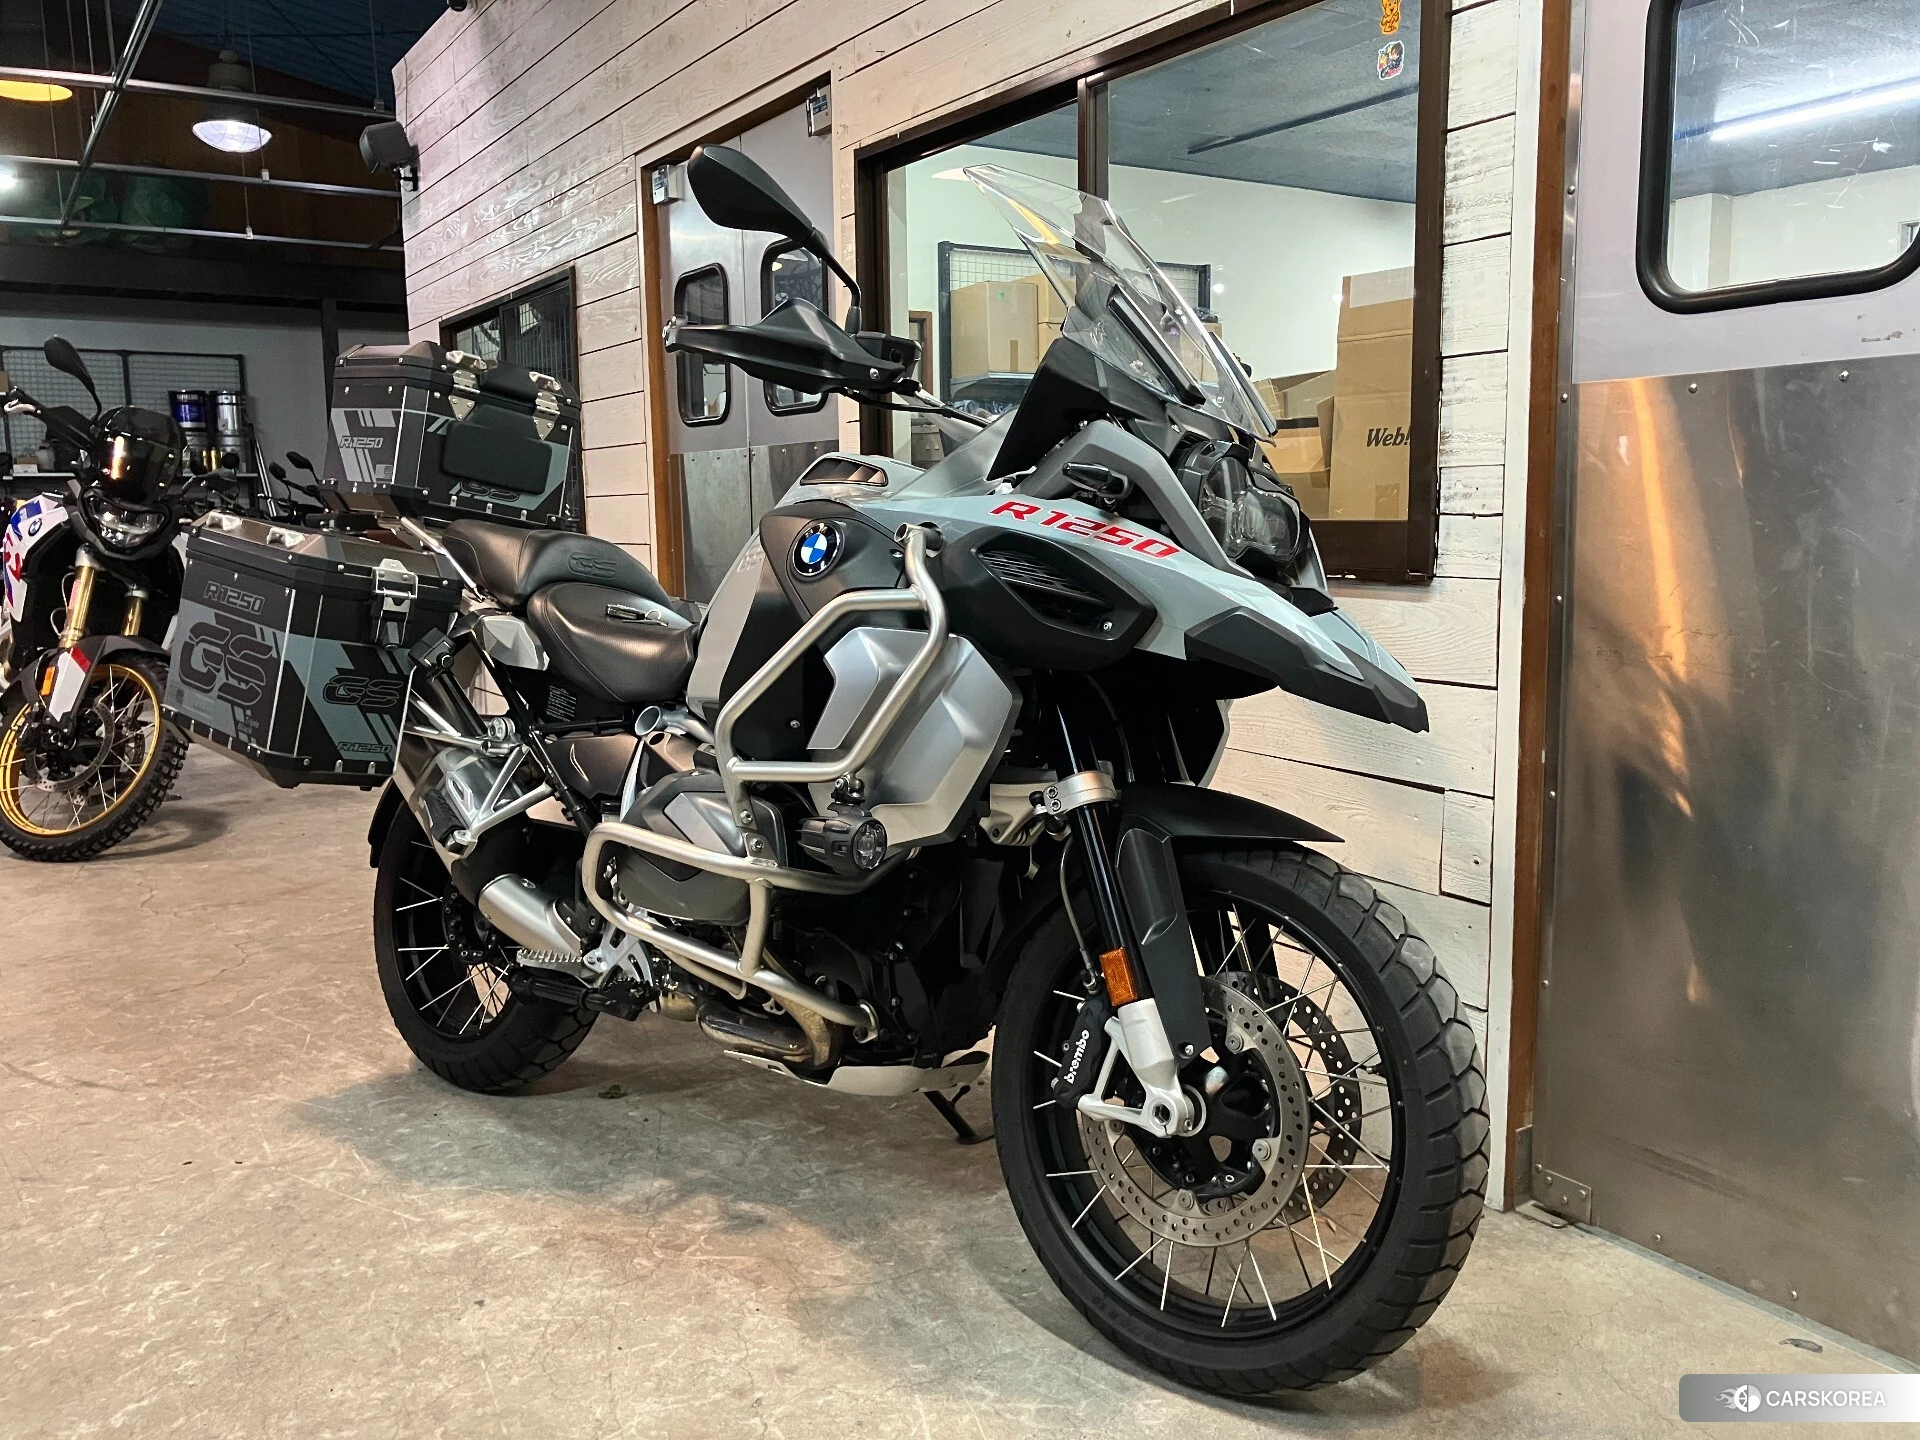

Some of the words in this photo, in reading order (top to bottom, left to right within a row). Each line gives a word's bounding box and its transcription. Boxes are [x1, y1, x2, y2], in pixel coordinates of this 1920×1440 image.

[203, 580, 265, 615] R1250
[179, 621, 273, 706] GS
[323, 675, 404, 708] GS
[337, 741, 393, 754] R1250
[1063, 1029, 1090, 1084] brembo
